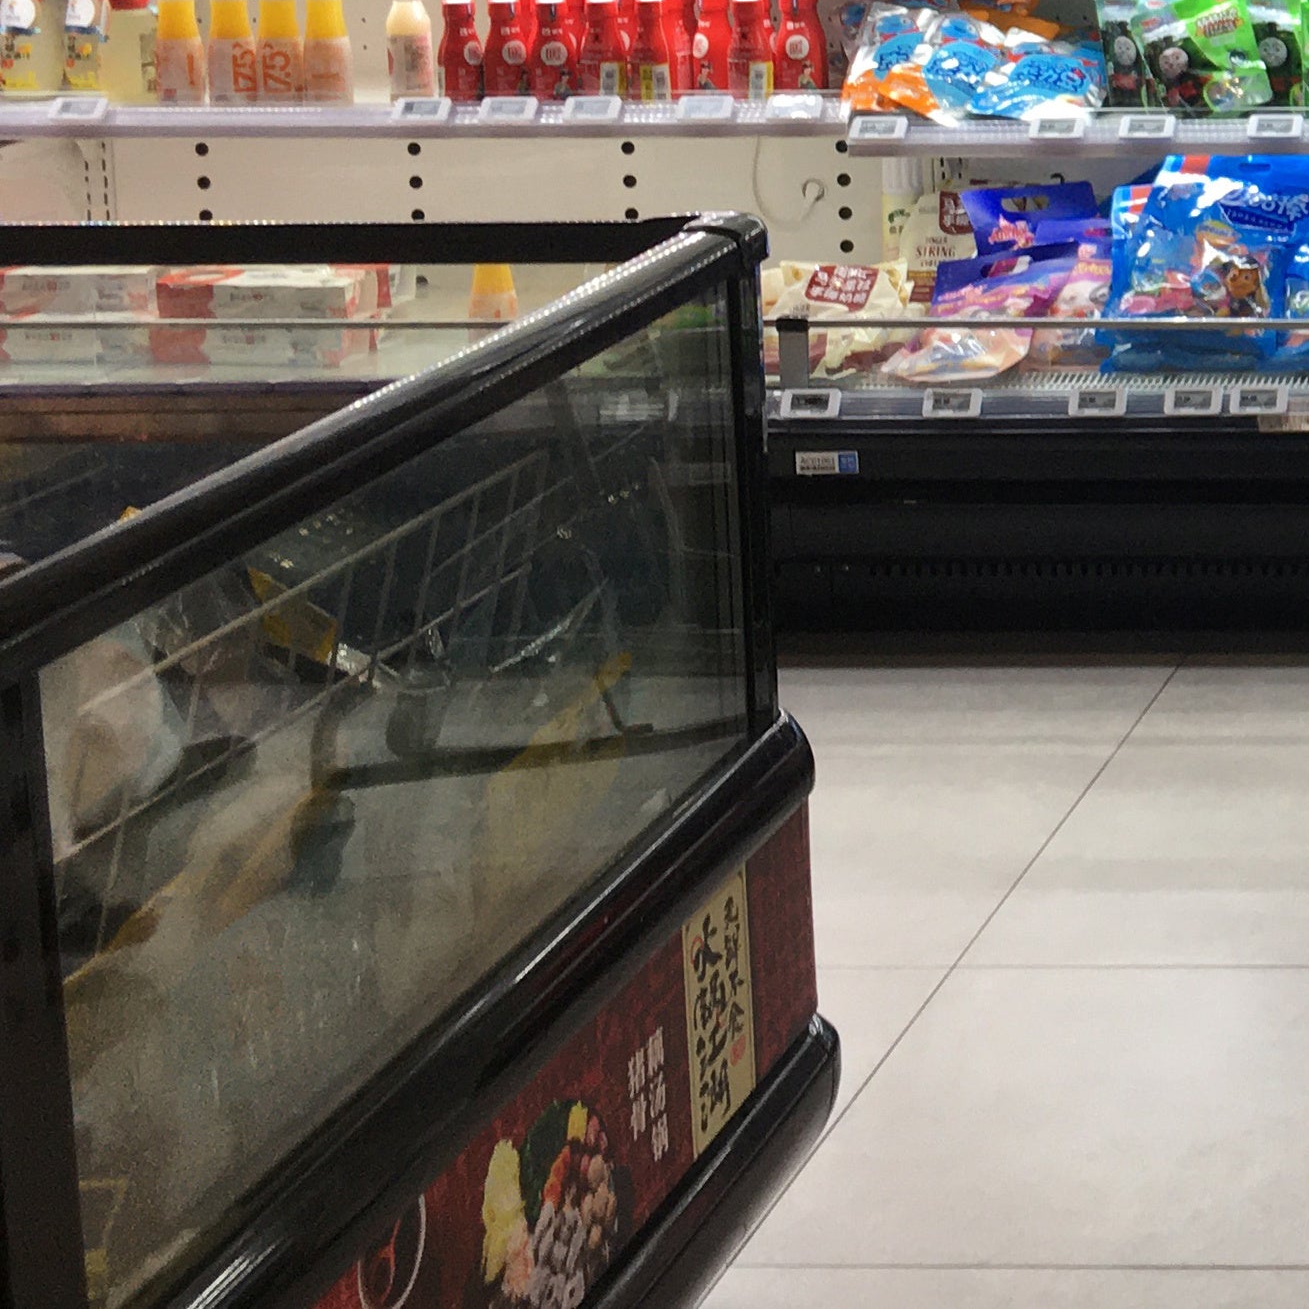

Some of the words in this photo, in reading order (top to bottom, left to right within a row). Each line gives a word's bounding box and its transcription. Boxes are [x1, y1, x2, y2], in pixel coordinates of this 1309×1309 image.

[916, 245, 955, 258] STRING
[691, 914, 731, 1134] 火锅江湖
